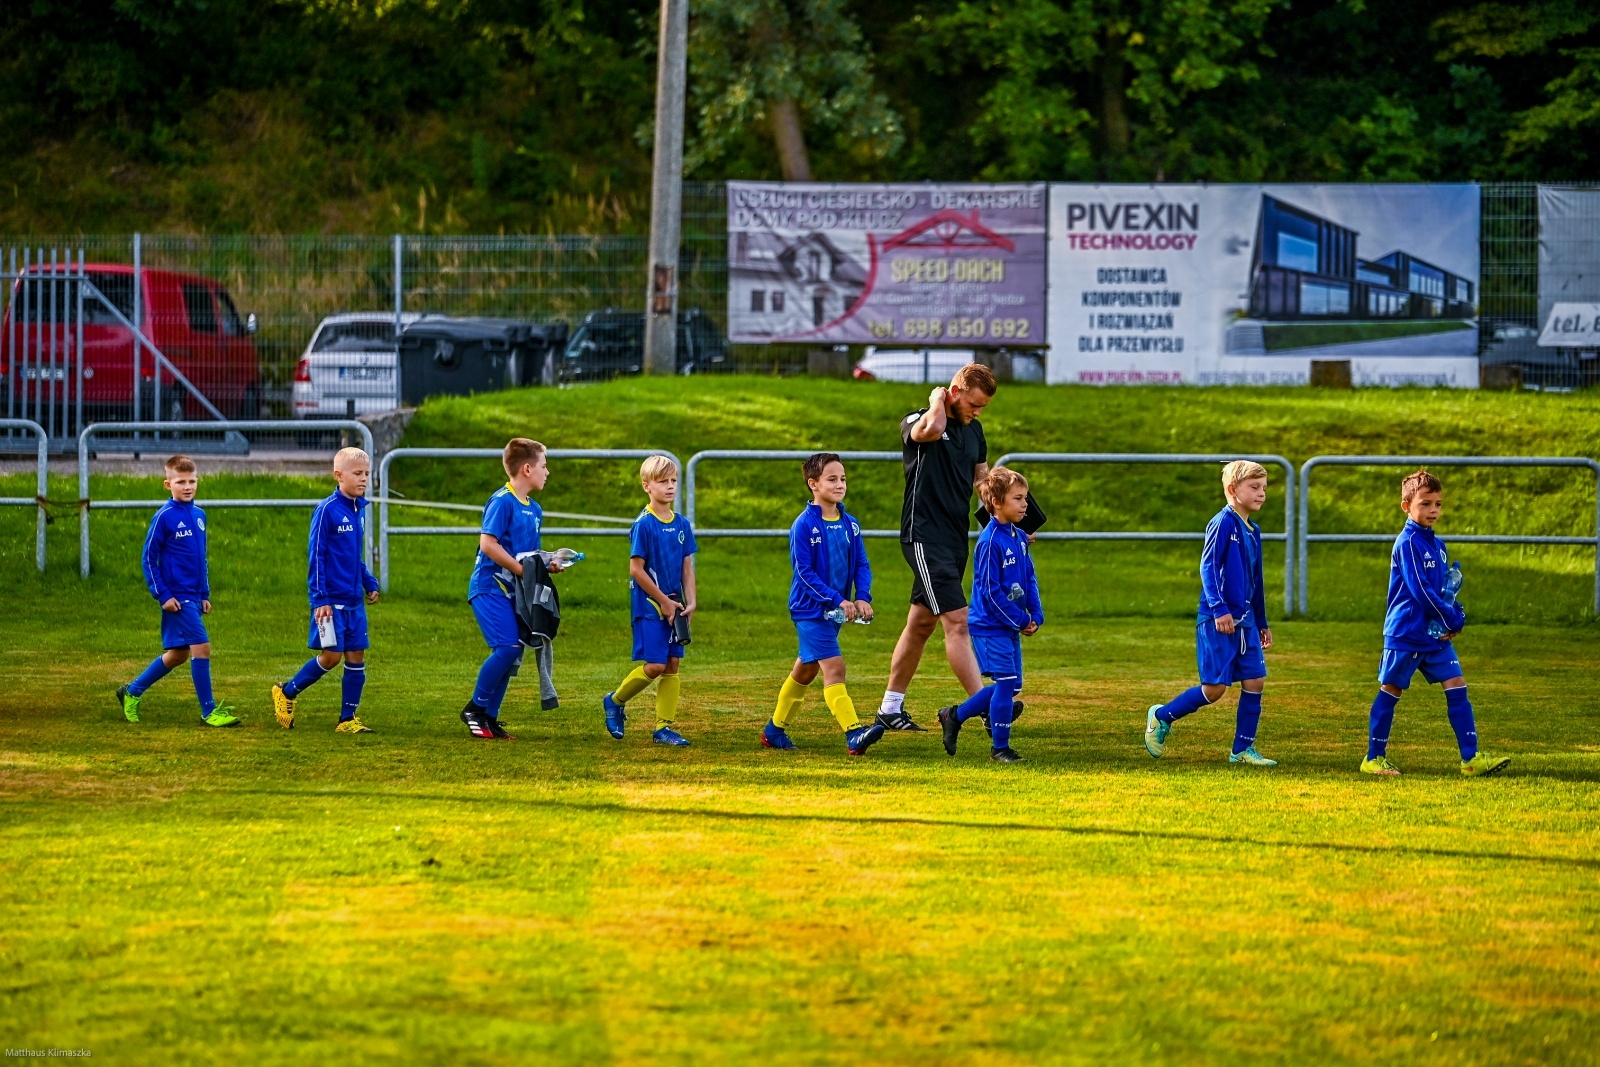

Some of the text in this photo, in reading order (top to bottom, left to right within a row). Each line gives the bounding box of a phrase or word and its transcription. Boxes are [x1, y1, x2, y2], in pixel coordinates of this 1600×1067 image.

[807, 191, 917, 210] CIESIELSKO
[930, 191, 1042, 210] DEKARSKIE
[796, 211, 839, 229] POD
[1067, 203, 1200, 231] PIVEXIN
[1068, 234, 1198, 250] TECHNOLOGY
[1097, 267, 1168, 285] DOSTAWCA
[1081, 286, 1182, 308] KOMPONENTÓW
[867, 318, 900, 339] tel.
[903, 318, 943, 339] 698
[990, 318, 1031, 339] 692
[1089, 310, 1175, 334] I ROZWIĄZAŃ
[1552, 312, 1586, 334] tel.
[1078, 336, 1184, 353] DLA PRZEMYSŁU
[175, 529, 193, 539] ALAS
[337, 524, 354, 533] ALAS
